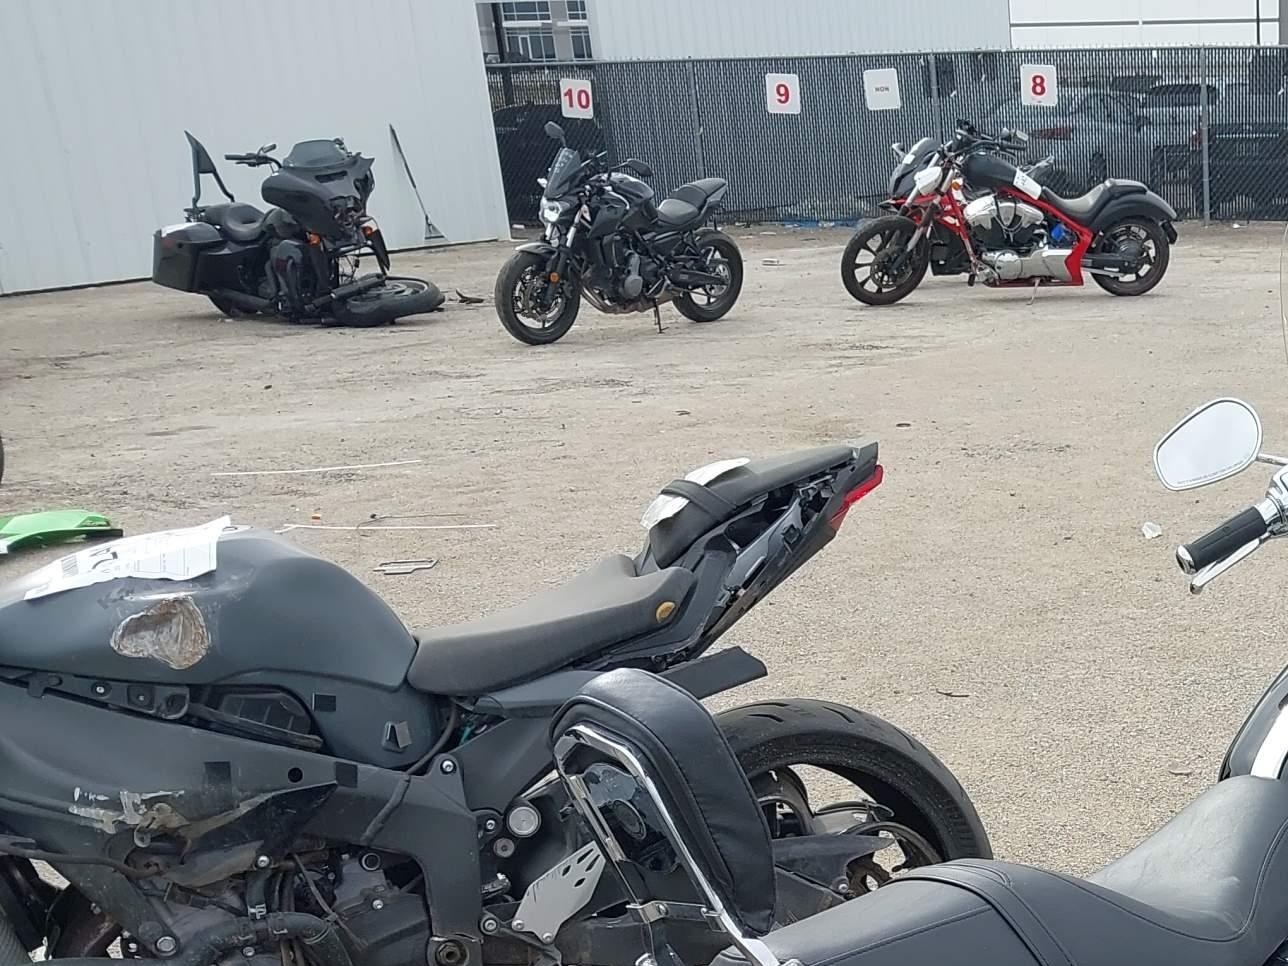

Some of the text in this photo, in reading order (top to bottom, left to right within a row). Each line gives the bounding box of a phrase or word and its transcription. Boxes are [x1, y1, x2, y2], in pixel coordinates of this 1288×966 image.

[775, 84, 790, 105] 9
[1031, 74, 1046, 96] 8
[563, 88, 592, 109] 10
